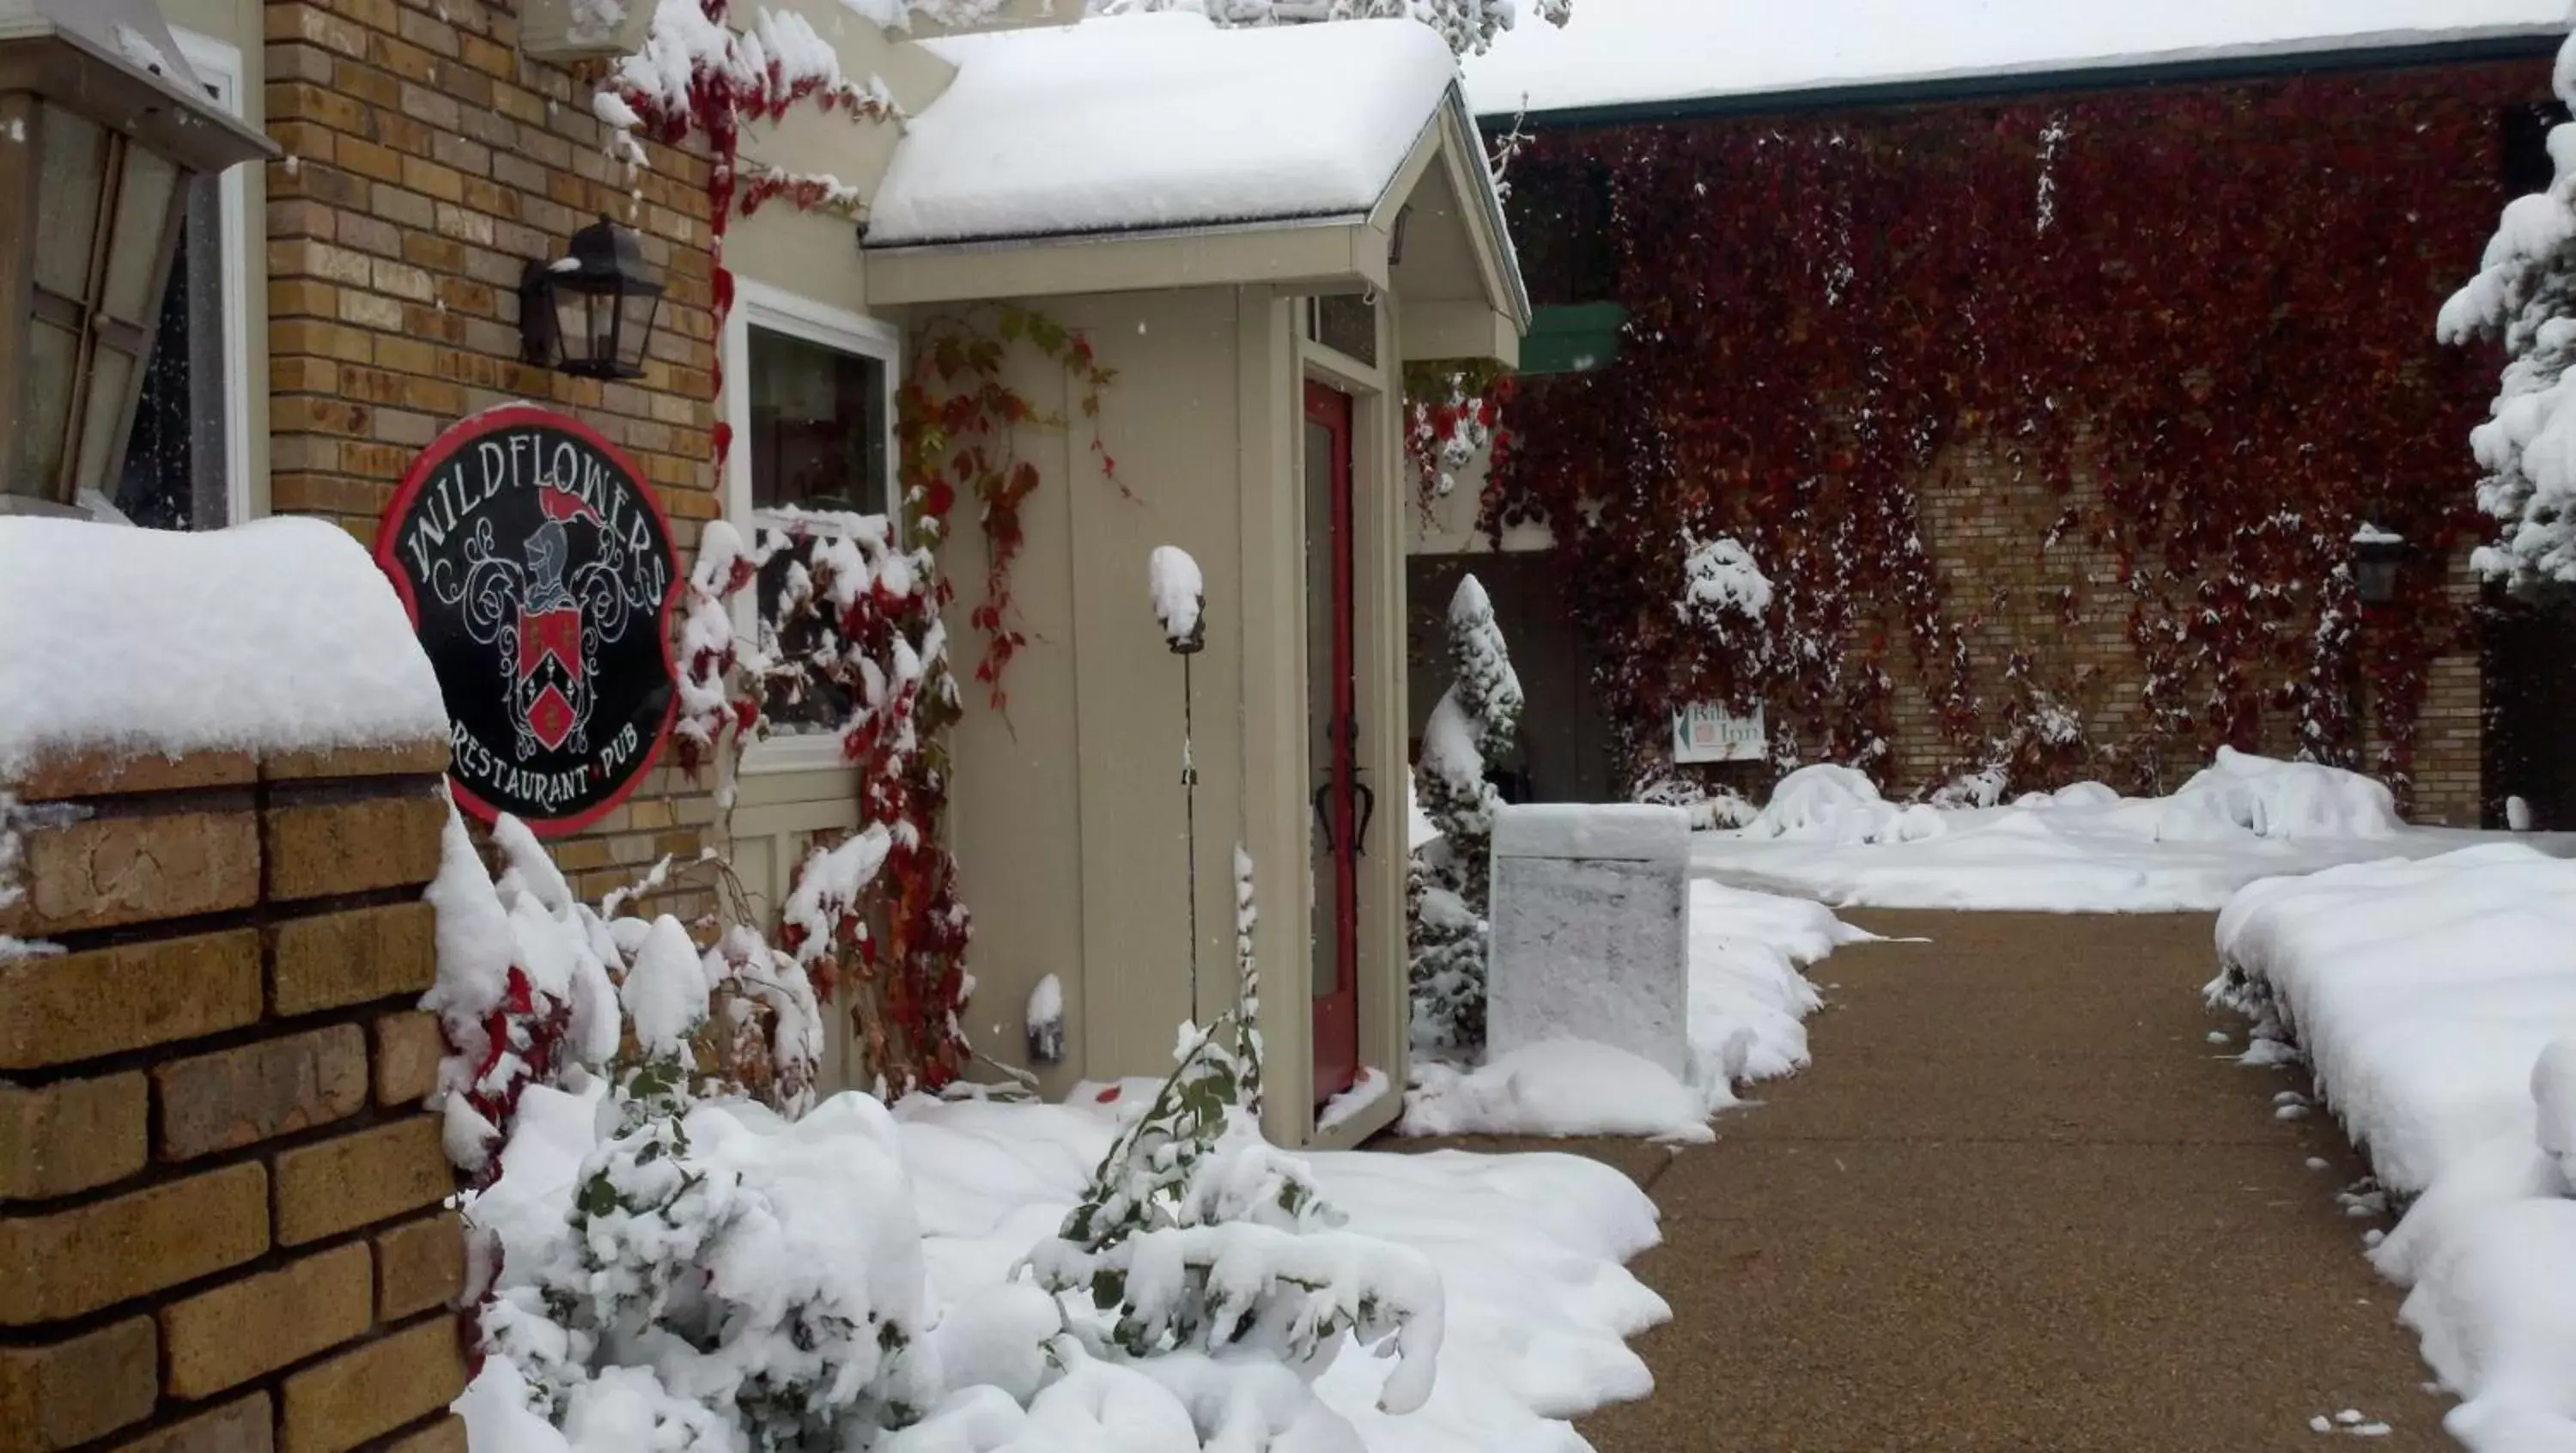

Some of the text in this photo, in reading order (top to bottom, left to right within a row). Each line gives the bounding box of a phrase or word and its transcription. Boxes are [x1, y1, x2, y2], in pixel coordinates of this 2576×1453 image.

[408, 435, 665, 617] WILDFLOWERS
[450, 719, 638, 812] RESTAURANT PUB
